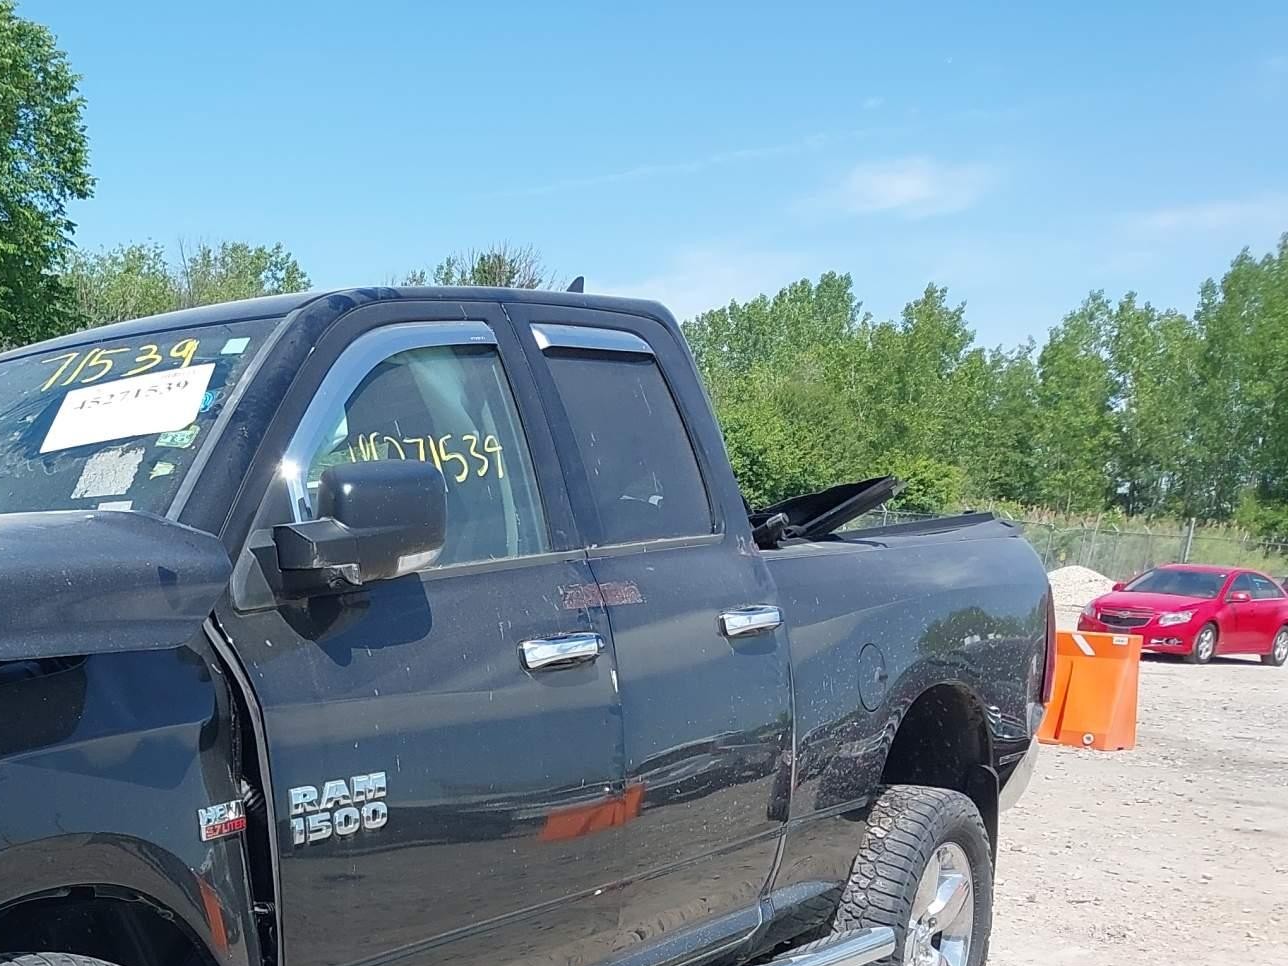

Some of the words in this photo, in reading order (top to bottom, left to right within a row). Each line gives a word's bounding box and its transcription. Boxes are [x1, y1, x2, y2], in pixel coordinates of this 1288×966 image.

[41, 338, 200, 392] 71539
[288, 771, 387, 814] RAM
[290, 801, 388, 845] 1500
